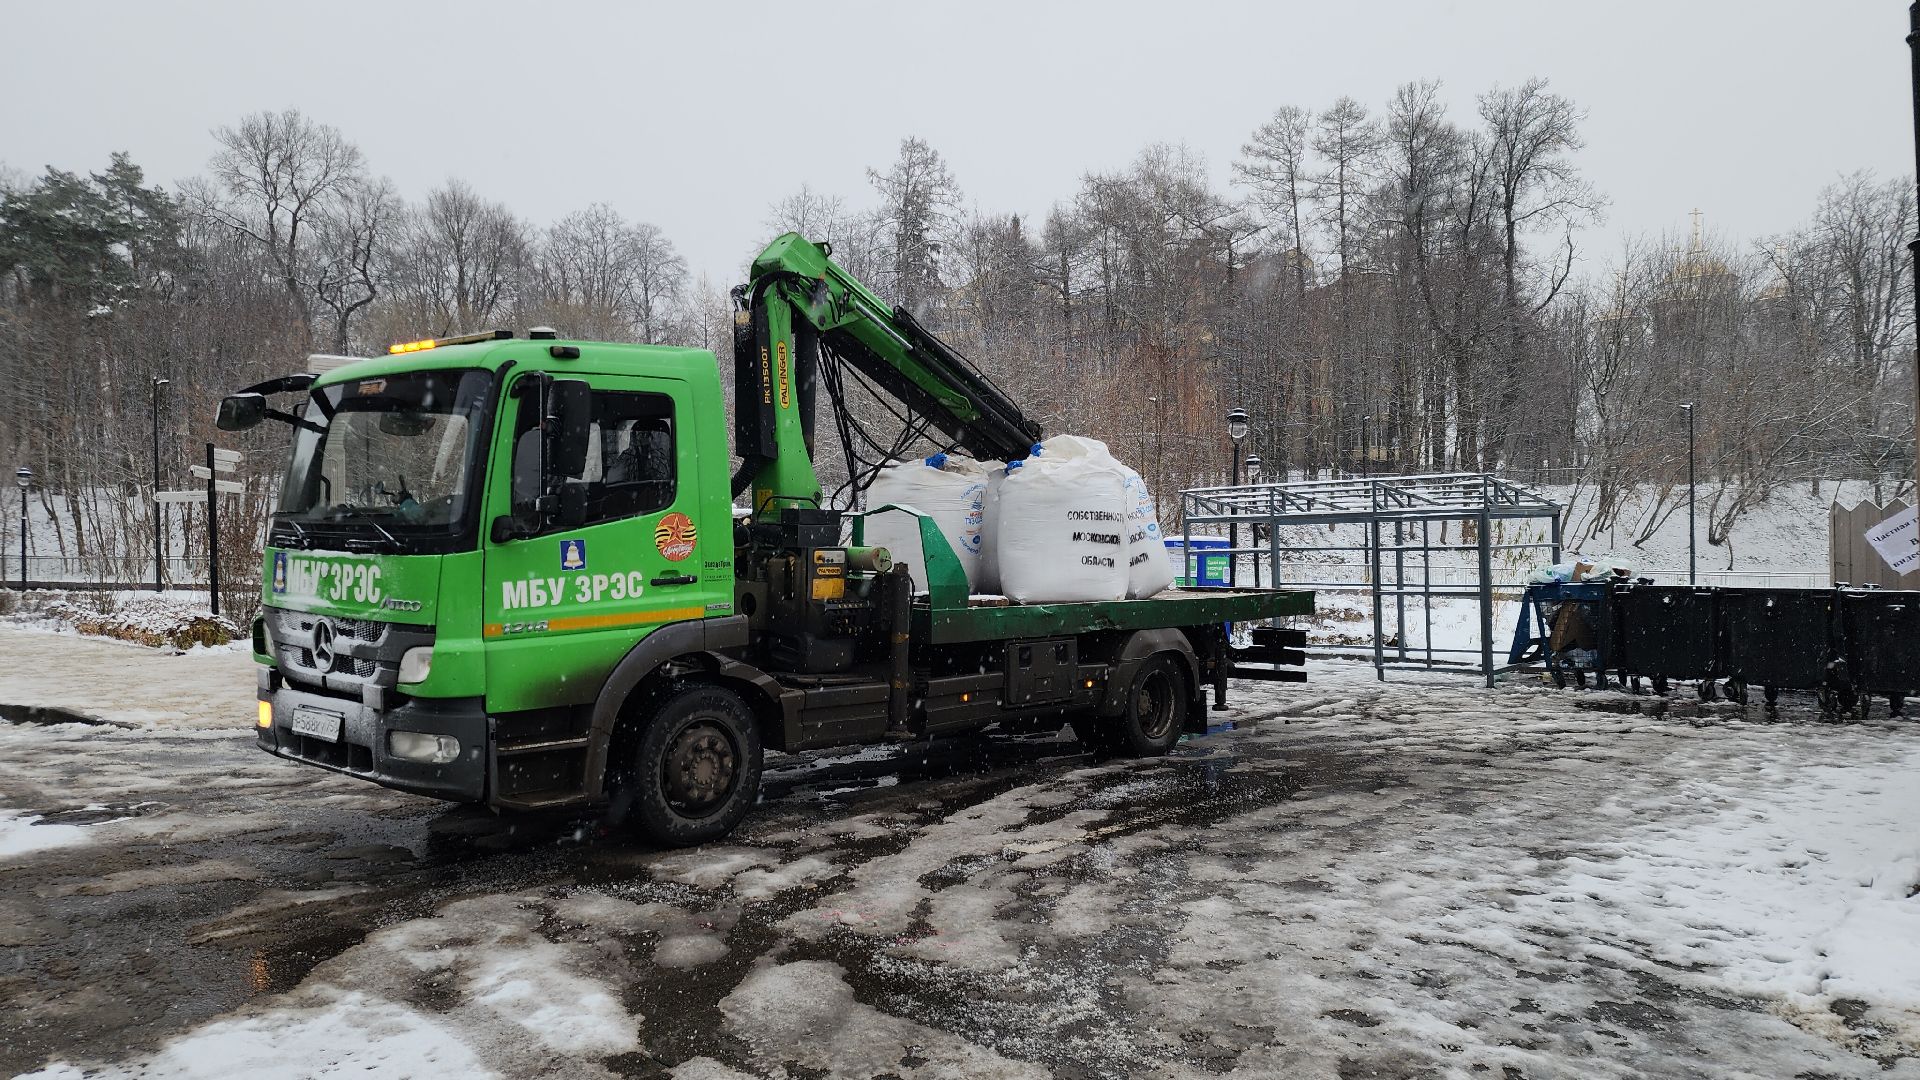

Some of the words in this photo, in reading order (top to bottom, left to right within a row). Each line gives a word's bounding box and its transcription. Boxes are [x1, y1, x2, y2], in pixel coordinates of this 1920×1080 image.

[778, 346, 788, 404] PALFINGER
[1872, 521, 1910, 542] Частная
[1081, 555, 1115, 568] ОБЛАСТИ
[286, 559, 321, 595] МБУ
[330, 562, 382, 604] ЗРЭС
[502, 576, 566, 610] МБУ
[575, 571, 645, 603] ЗРЭС
